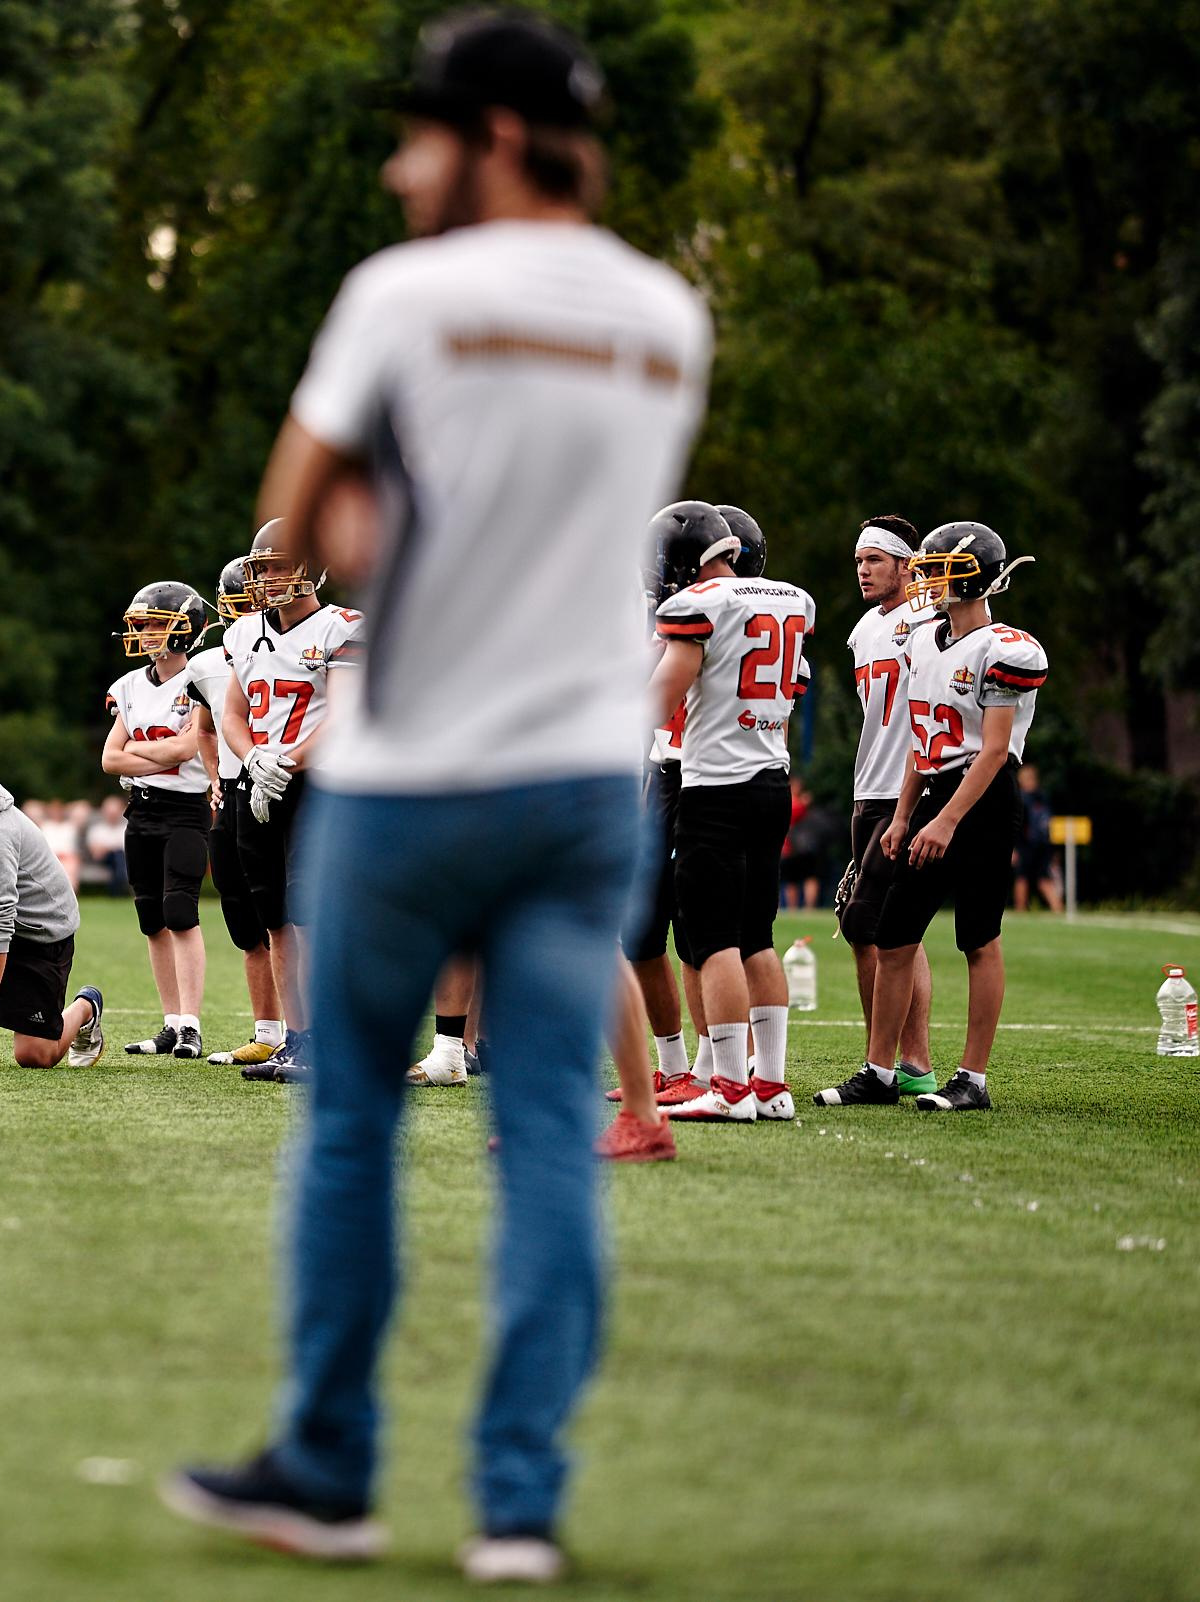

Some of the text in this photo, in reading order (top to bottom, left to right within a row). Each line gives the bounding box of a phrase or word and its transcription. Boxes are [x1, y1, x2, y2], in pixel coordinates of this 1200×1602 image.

[737, 613, 805, 700] 20
[248, 679, 315, 745] 27
[855, 658, 900, 726] 77
[908, 699, 964, 771] 52
